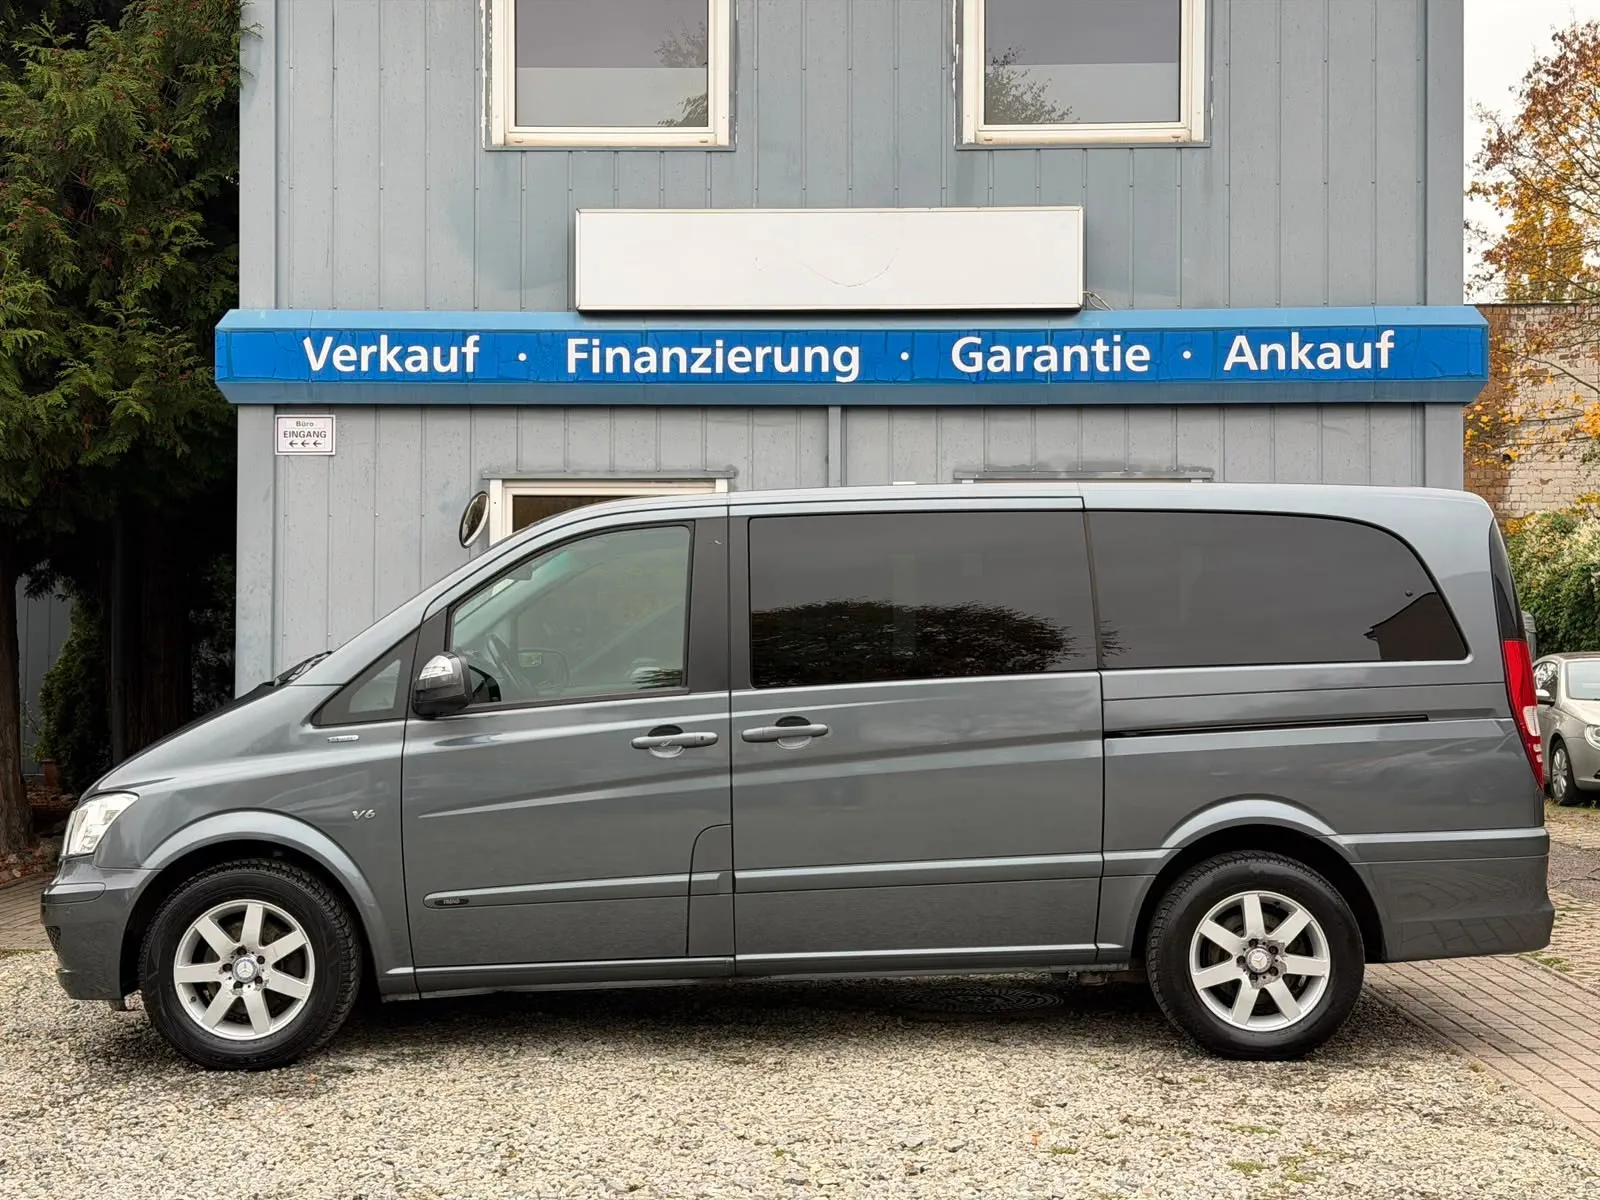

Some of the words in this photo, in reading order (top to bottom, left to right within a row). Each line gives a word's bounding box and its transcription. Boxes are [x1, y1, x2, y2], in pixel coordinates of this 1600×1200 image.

[302, 334, 480, 373] Verkauf
[567, 338, 860, 383] Finanzierung
[951, 336, 1151, 373] Garantie
[1223, 330, 1395, 371] Ankauf
[283, 430, 327, 439] EINGANG
[352, 809, 376, 820] V6
